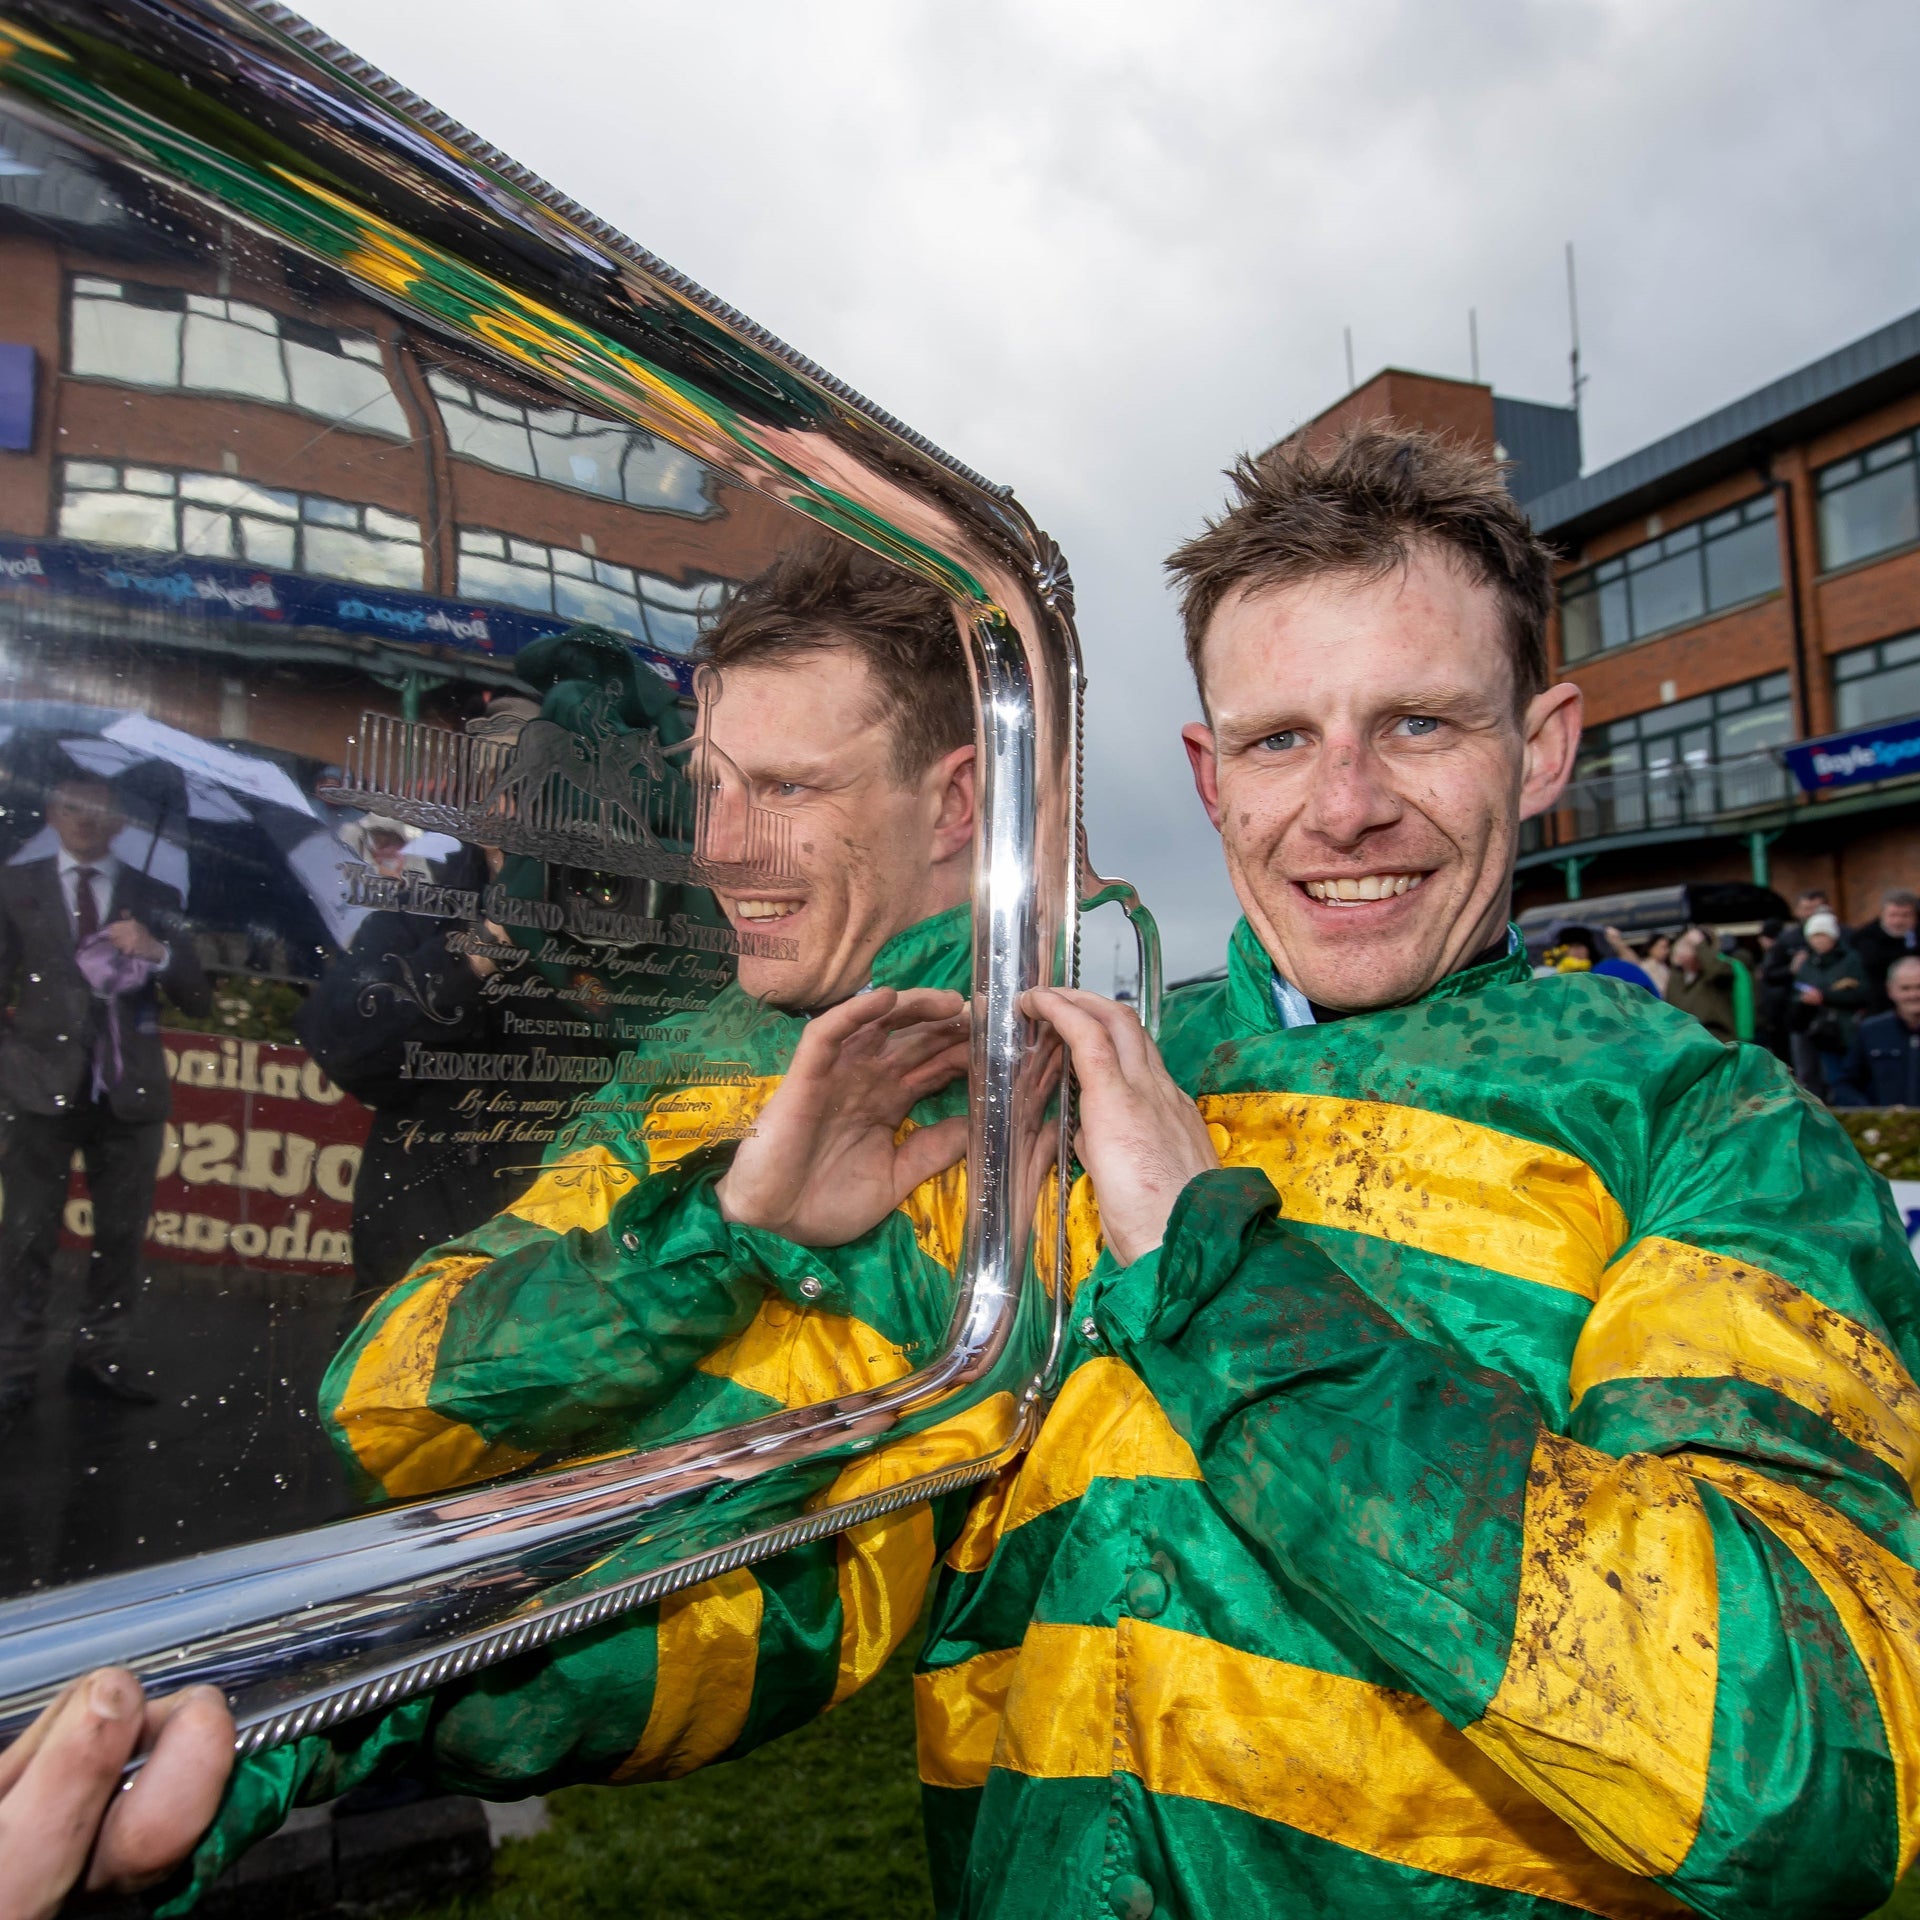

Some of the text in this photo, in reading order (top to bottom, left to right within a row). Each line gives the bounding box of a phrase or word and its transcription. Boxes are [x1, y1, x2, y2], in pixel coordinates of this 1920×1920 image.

[401, 869, 480, 921] IRISH
[482, 883, 565, 931] GRAND
[566, 898, 667, 946] NATIONAL
[593, 946, 682, 980] Perpetual
[679, 954, 735, 989] Trophy
[596, 985, 667, 1008] endowed
[503, 1011, 692, 1043] PRESENTED IN MEMORY OF
[399, 1041, 529, 1080] FREDERICK
[527, 1047, 614, 1083] EDWARD
[450, 1088, 713, 1121] By his many friends and admirers
[383, 1119, 425, 1155] As
[429, 1131, 447, 1144] a
[450, 1119, 510, 1143] small
[506, 1120, 556, 1143] token
[558, 1121, 588, 1150] of
[582, 1120, 622, 1142] their
[625, 1120, 673, 1142] esteem
[675, 1121, 709, 1141] and
